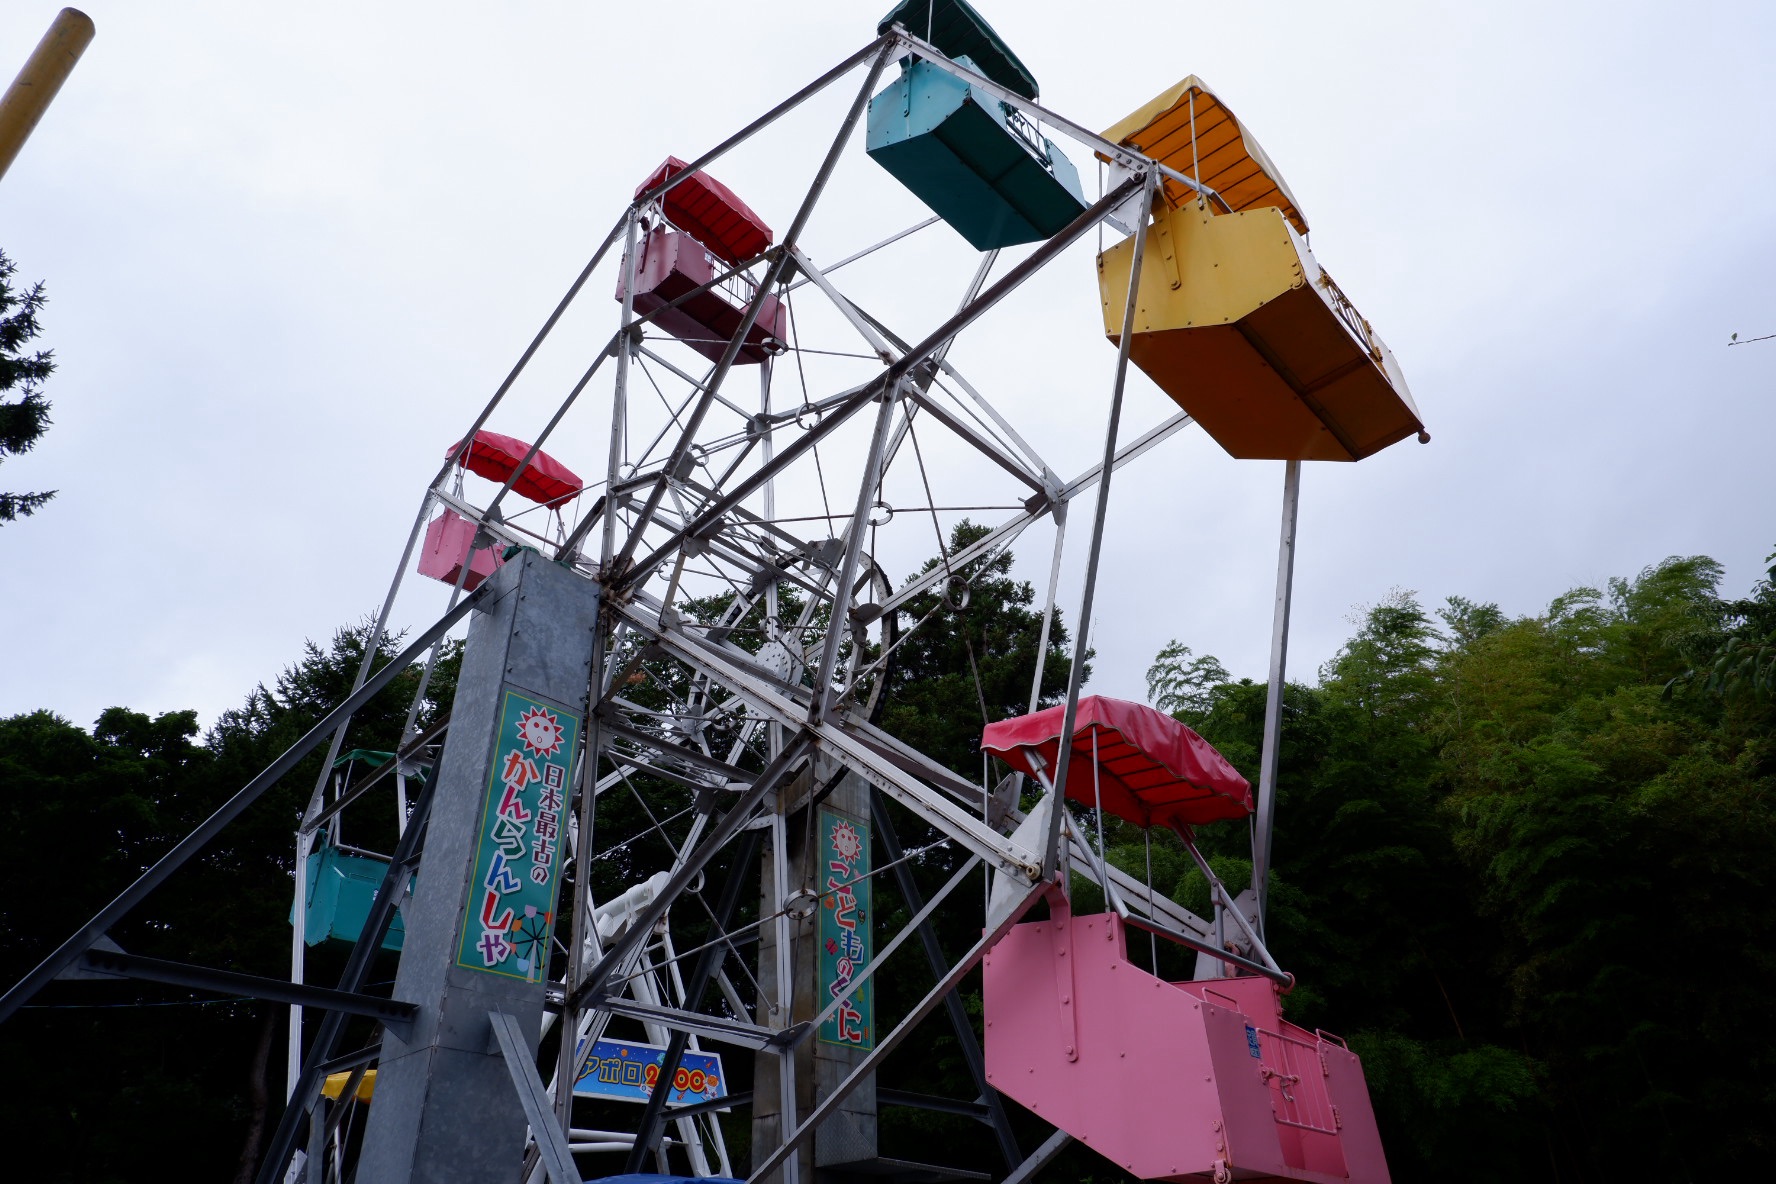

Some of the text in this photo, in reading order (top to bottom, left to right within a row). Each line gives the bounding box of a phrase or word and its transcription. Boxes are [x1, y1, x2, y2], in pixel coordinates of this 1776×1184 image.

[530, 762, 565, 885] 日本最古の
[827, 860, 864, 1043] こどものくに
[578, 1056, 706, 1093] アポロ200
